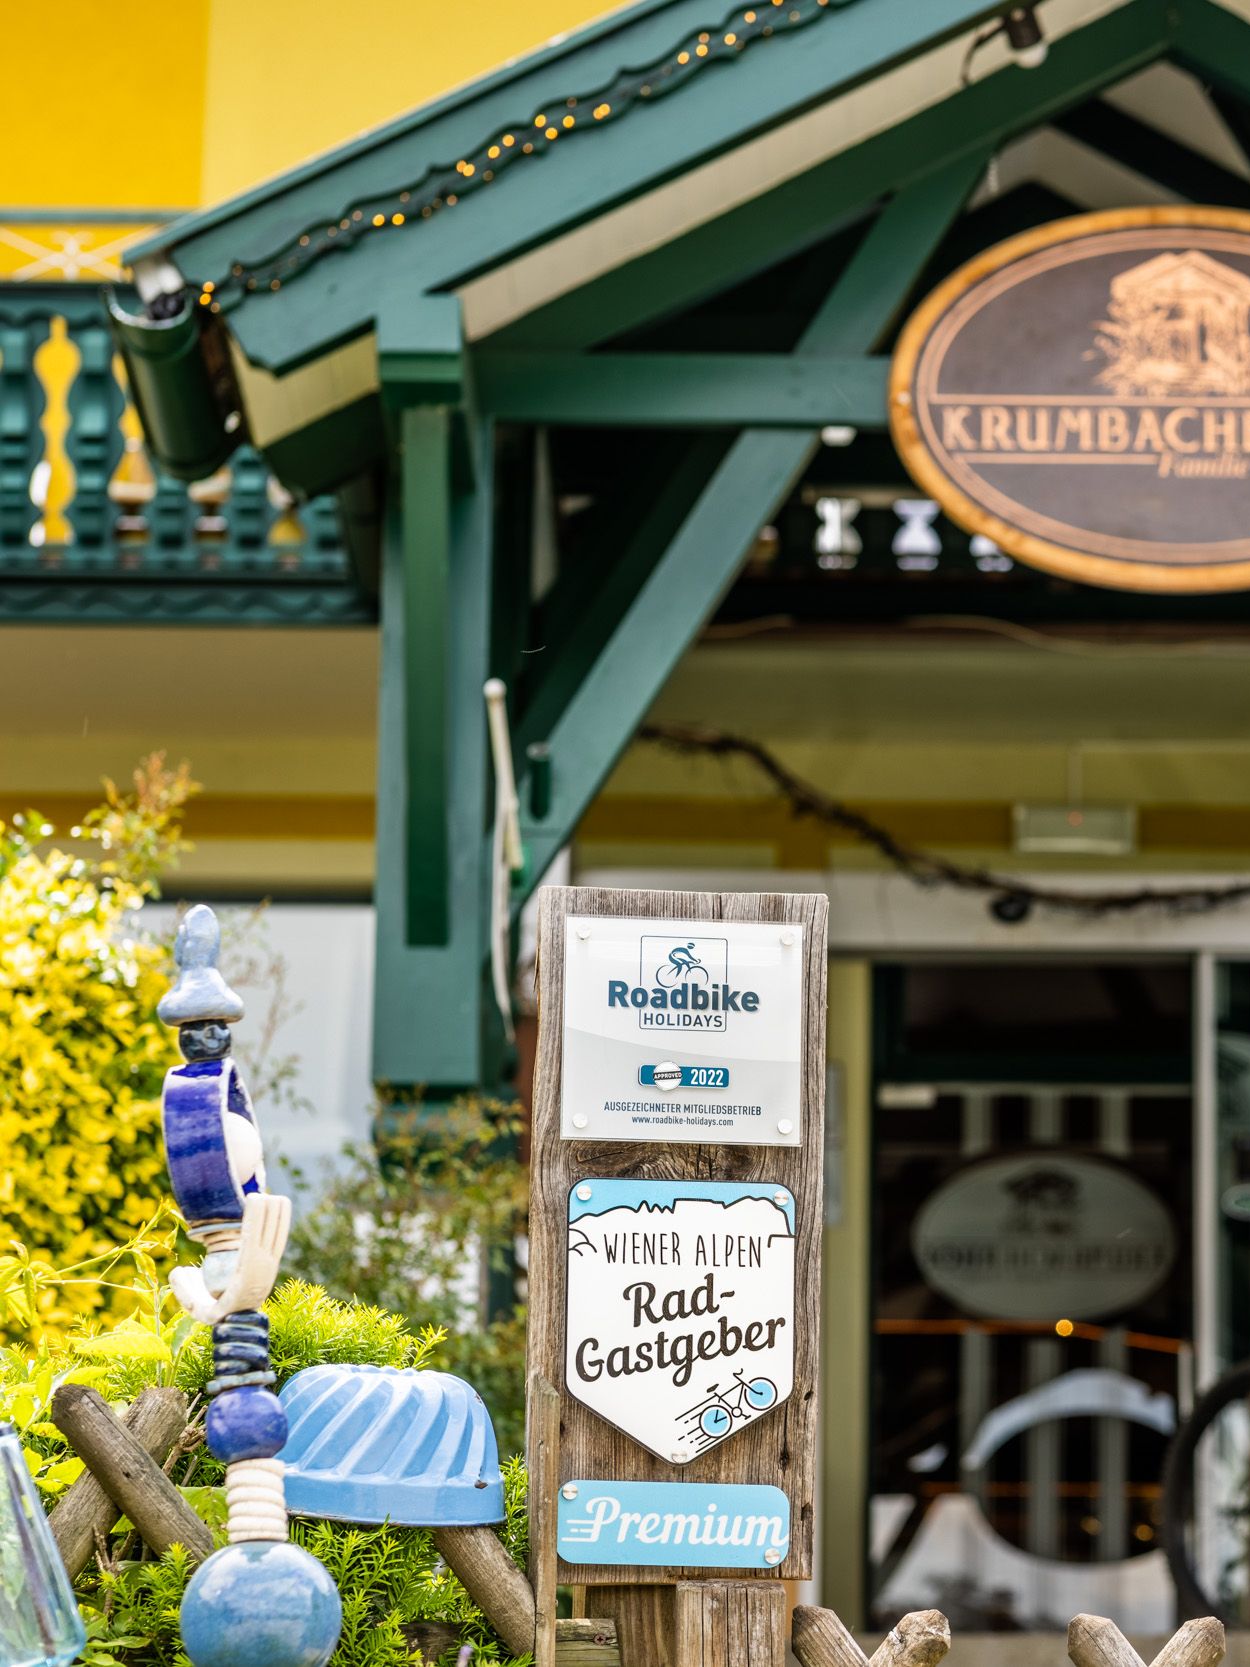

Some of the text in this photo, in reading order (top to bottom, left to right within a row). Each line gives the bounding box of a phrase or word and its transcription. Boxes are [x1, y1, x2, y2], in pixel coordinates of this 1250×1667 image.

[608, 980, 759, 1012] Roadbike
[643, 1013, 723, 1028] HOLIDAYS
[690, 1069, 724, 1086] 2022
[603, 1101, 762, 1116] AUSGEZEICHNETER MITGLIEDSBETRIEB
[631, 1115, 734, 1127] www.roadbike-holidays.com
[603, 1232, 763, 1268] WIENER ALPEN
[622, 1272, 736, 1328] Rad-
[575, 1316, 786, 1388] Gastgeber
[584, 1496, 788, 1547] Premium
